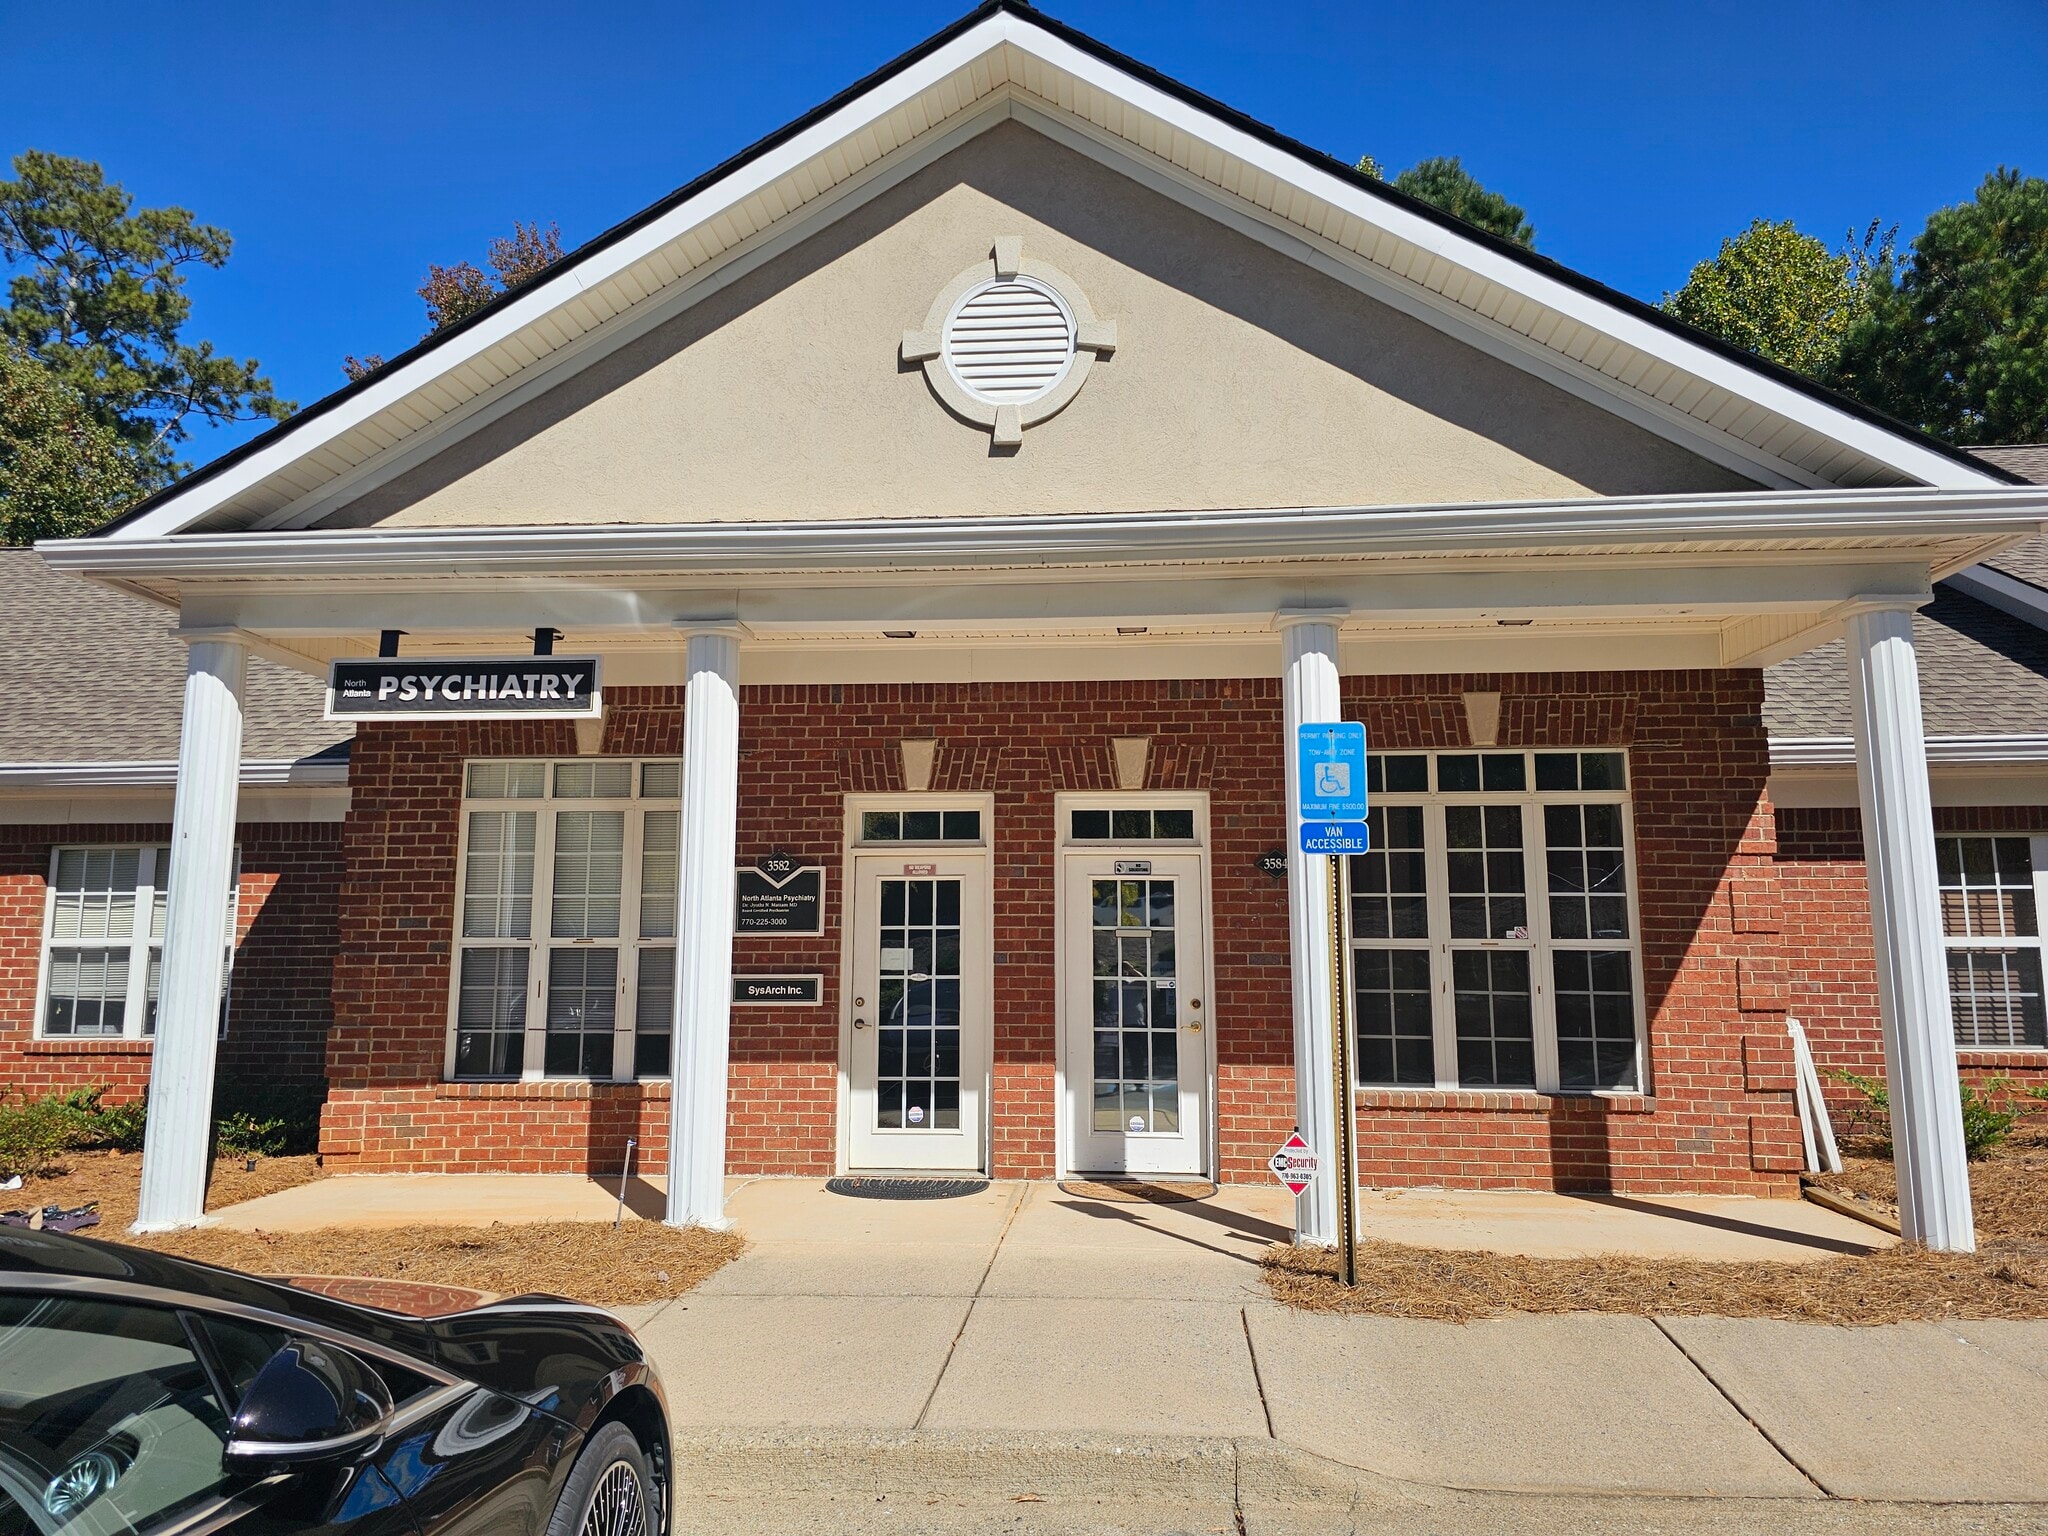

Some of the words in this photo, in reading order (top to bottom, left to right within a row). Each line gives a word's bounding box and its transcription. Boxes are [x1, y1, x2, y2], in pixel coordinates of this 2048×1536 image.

[344, 679, 367, 688] North
[377, 673, 585, 701] PSYCHIATRY
[342, 688, 372, 698] Atlanta
[1340, 748, 1356, 756] ZONE
[1325, 826, 1343, 837] VAN
[1305, 838, 1364, 849] ACCESSIBLE
[767, 860, 790, 871] 3582
[742, 894, 759, 902] North
[760, 894, 782, 902] Atlanta
[783, 894, 816, 903] Psychiatry
[741, 918, 788, 926] 770-225-3000
[748, 985, 786, 996] SysArch
[787, 985, 804, 995] Inc.
[1287, 1156, 1318, 1171] Security
